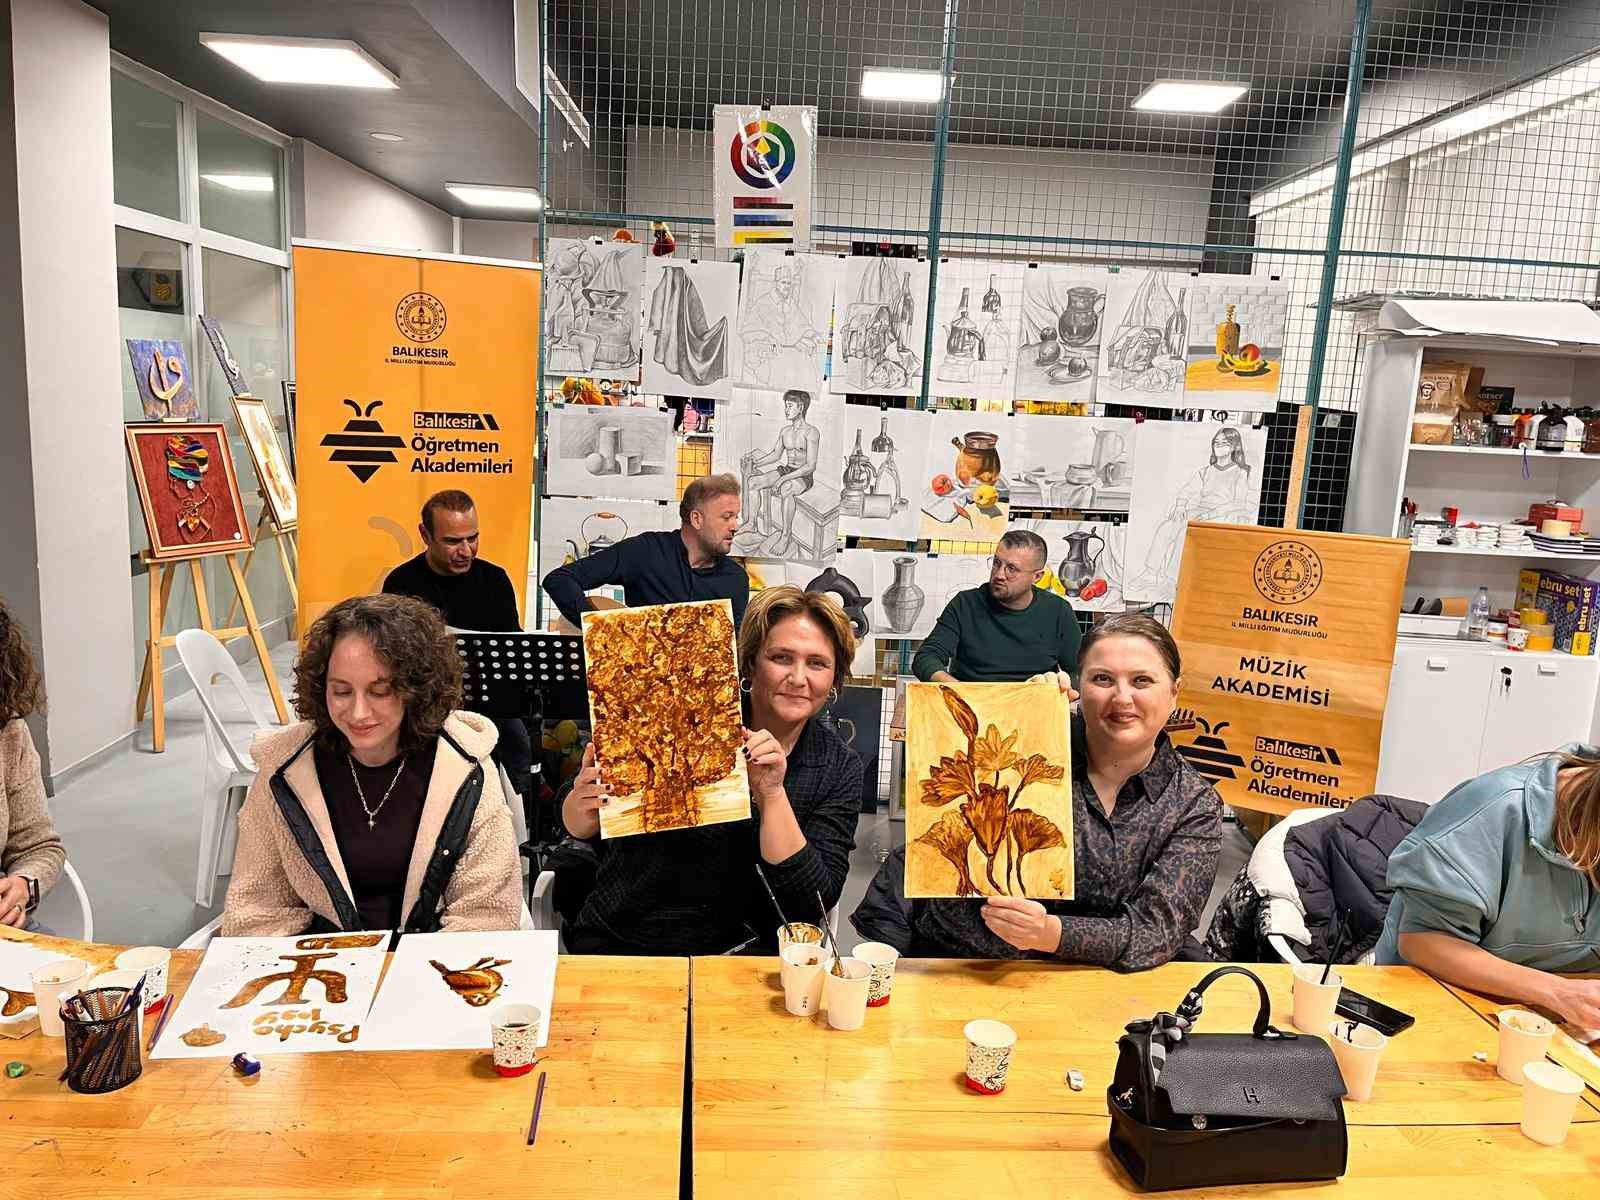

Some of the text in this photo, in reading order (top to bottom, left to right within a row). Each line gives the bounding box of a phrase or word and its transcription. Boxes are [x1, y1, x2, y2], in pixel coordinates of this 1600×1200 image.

[414, 413, 480, 429] Balıkesir
[411, 432, 499, 456] Öğretmen
[410, 457, 513, 474] Akademileri
[1540, 577, 1563, 594] ebru
[1564, 584, 1580, 598] set
[1242, 607, 1319, 628] BALIKESİR
[1578, 605, 1590, 631] ebru
[1239, 656, 1307, 680] MÜZİK
[1211, 676, 1330, 707] AKADEMİSİ
[1256, 737, 1321, 761] Balıkesir
[1250, 755, 1339, 788] Öğretmen
